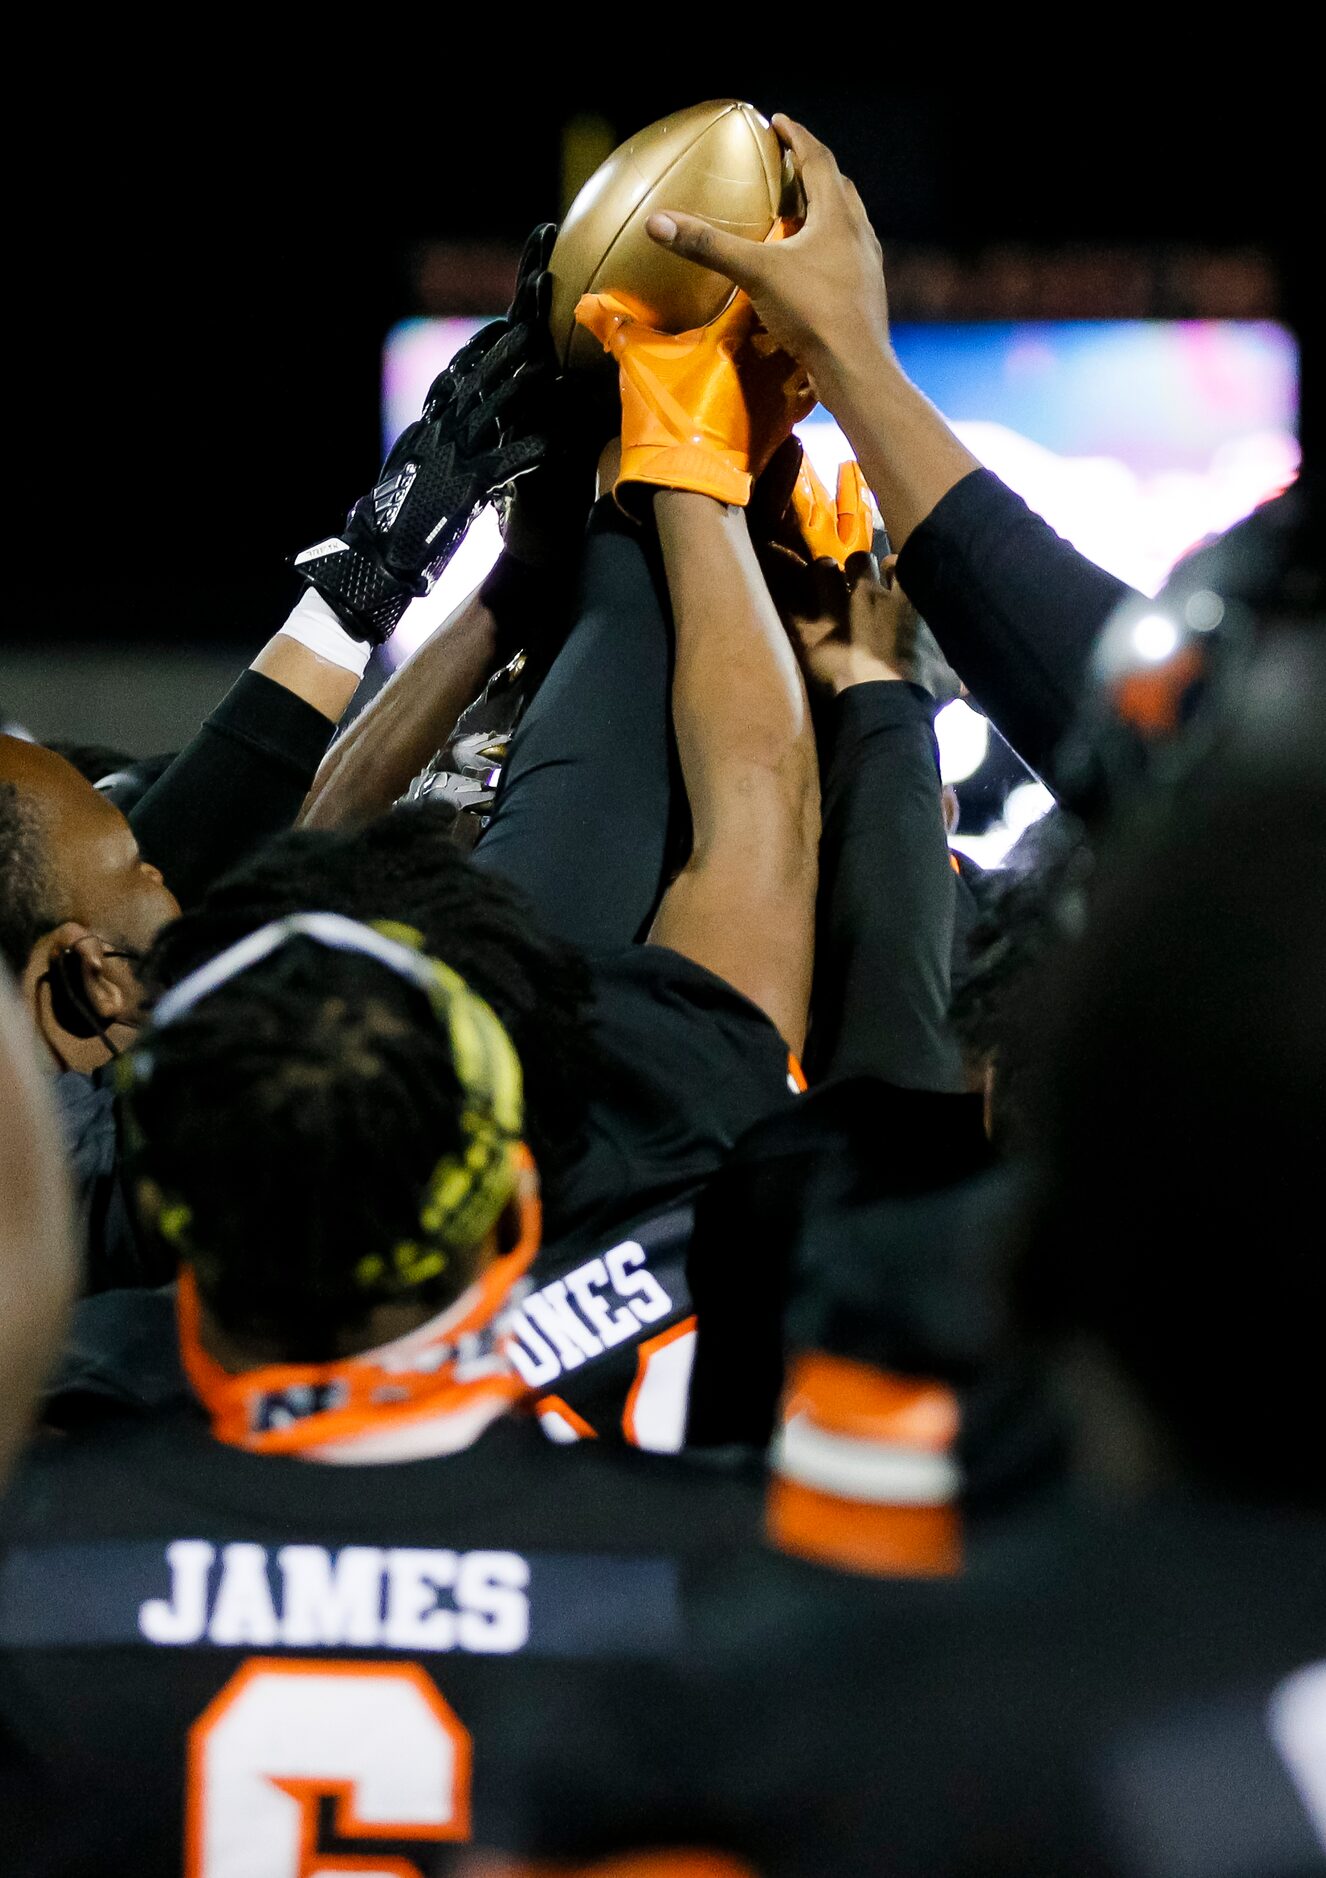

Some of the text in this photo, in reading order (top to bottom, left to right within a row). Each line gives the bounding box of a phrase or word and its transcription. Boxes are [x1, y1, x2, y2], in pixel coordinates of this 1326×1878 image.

[504, 1240, 672, 1387] ONES
[139, 1540, 530, 1653] JAMES
[183, 1656, 473, 1878] 6
